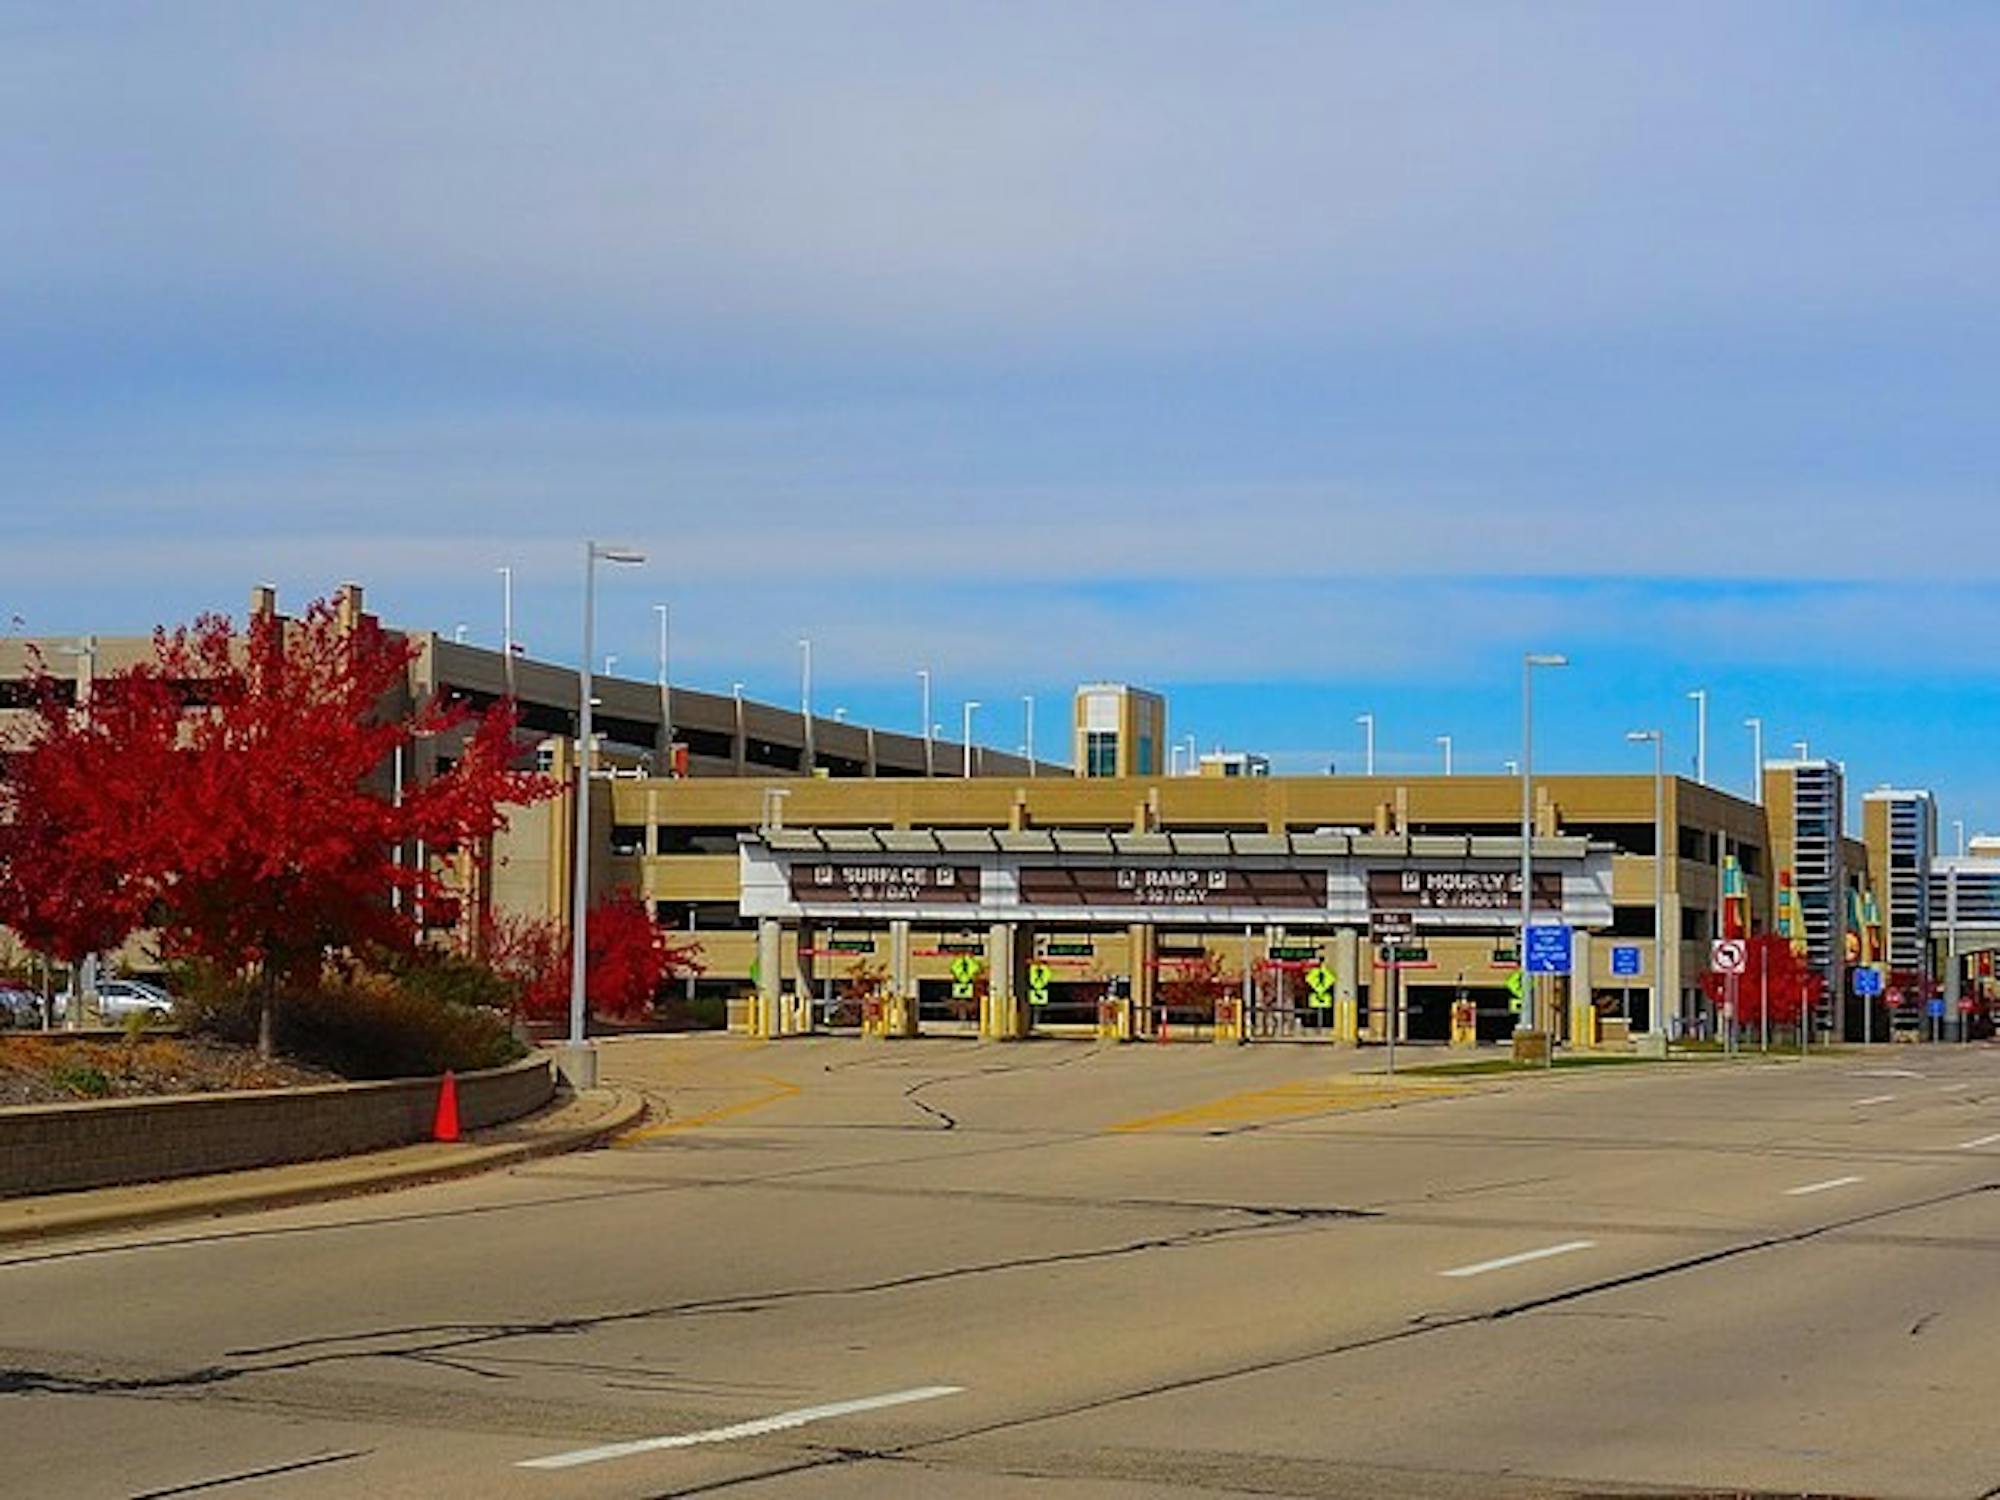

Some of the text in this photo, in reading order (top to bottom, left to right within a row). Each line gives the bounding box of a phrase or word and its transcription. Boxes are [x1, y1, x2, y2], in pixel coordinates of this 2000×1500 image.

[842, 867, 927, 884] SURFACE
[1145, 870, 1199, 886] RAMP
[1427, 873, 1505, 890] HOURLY
